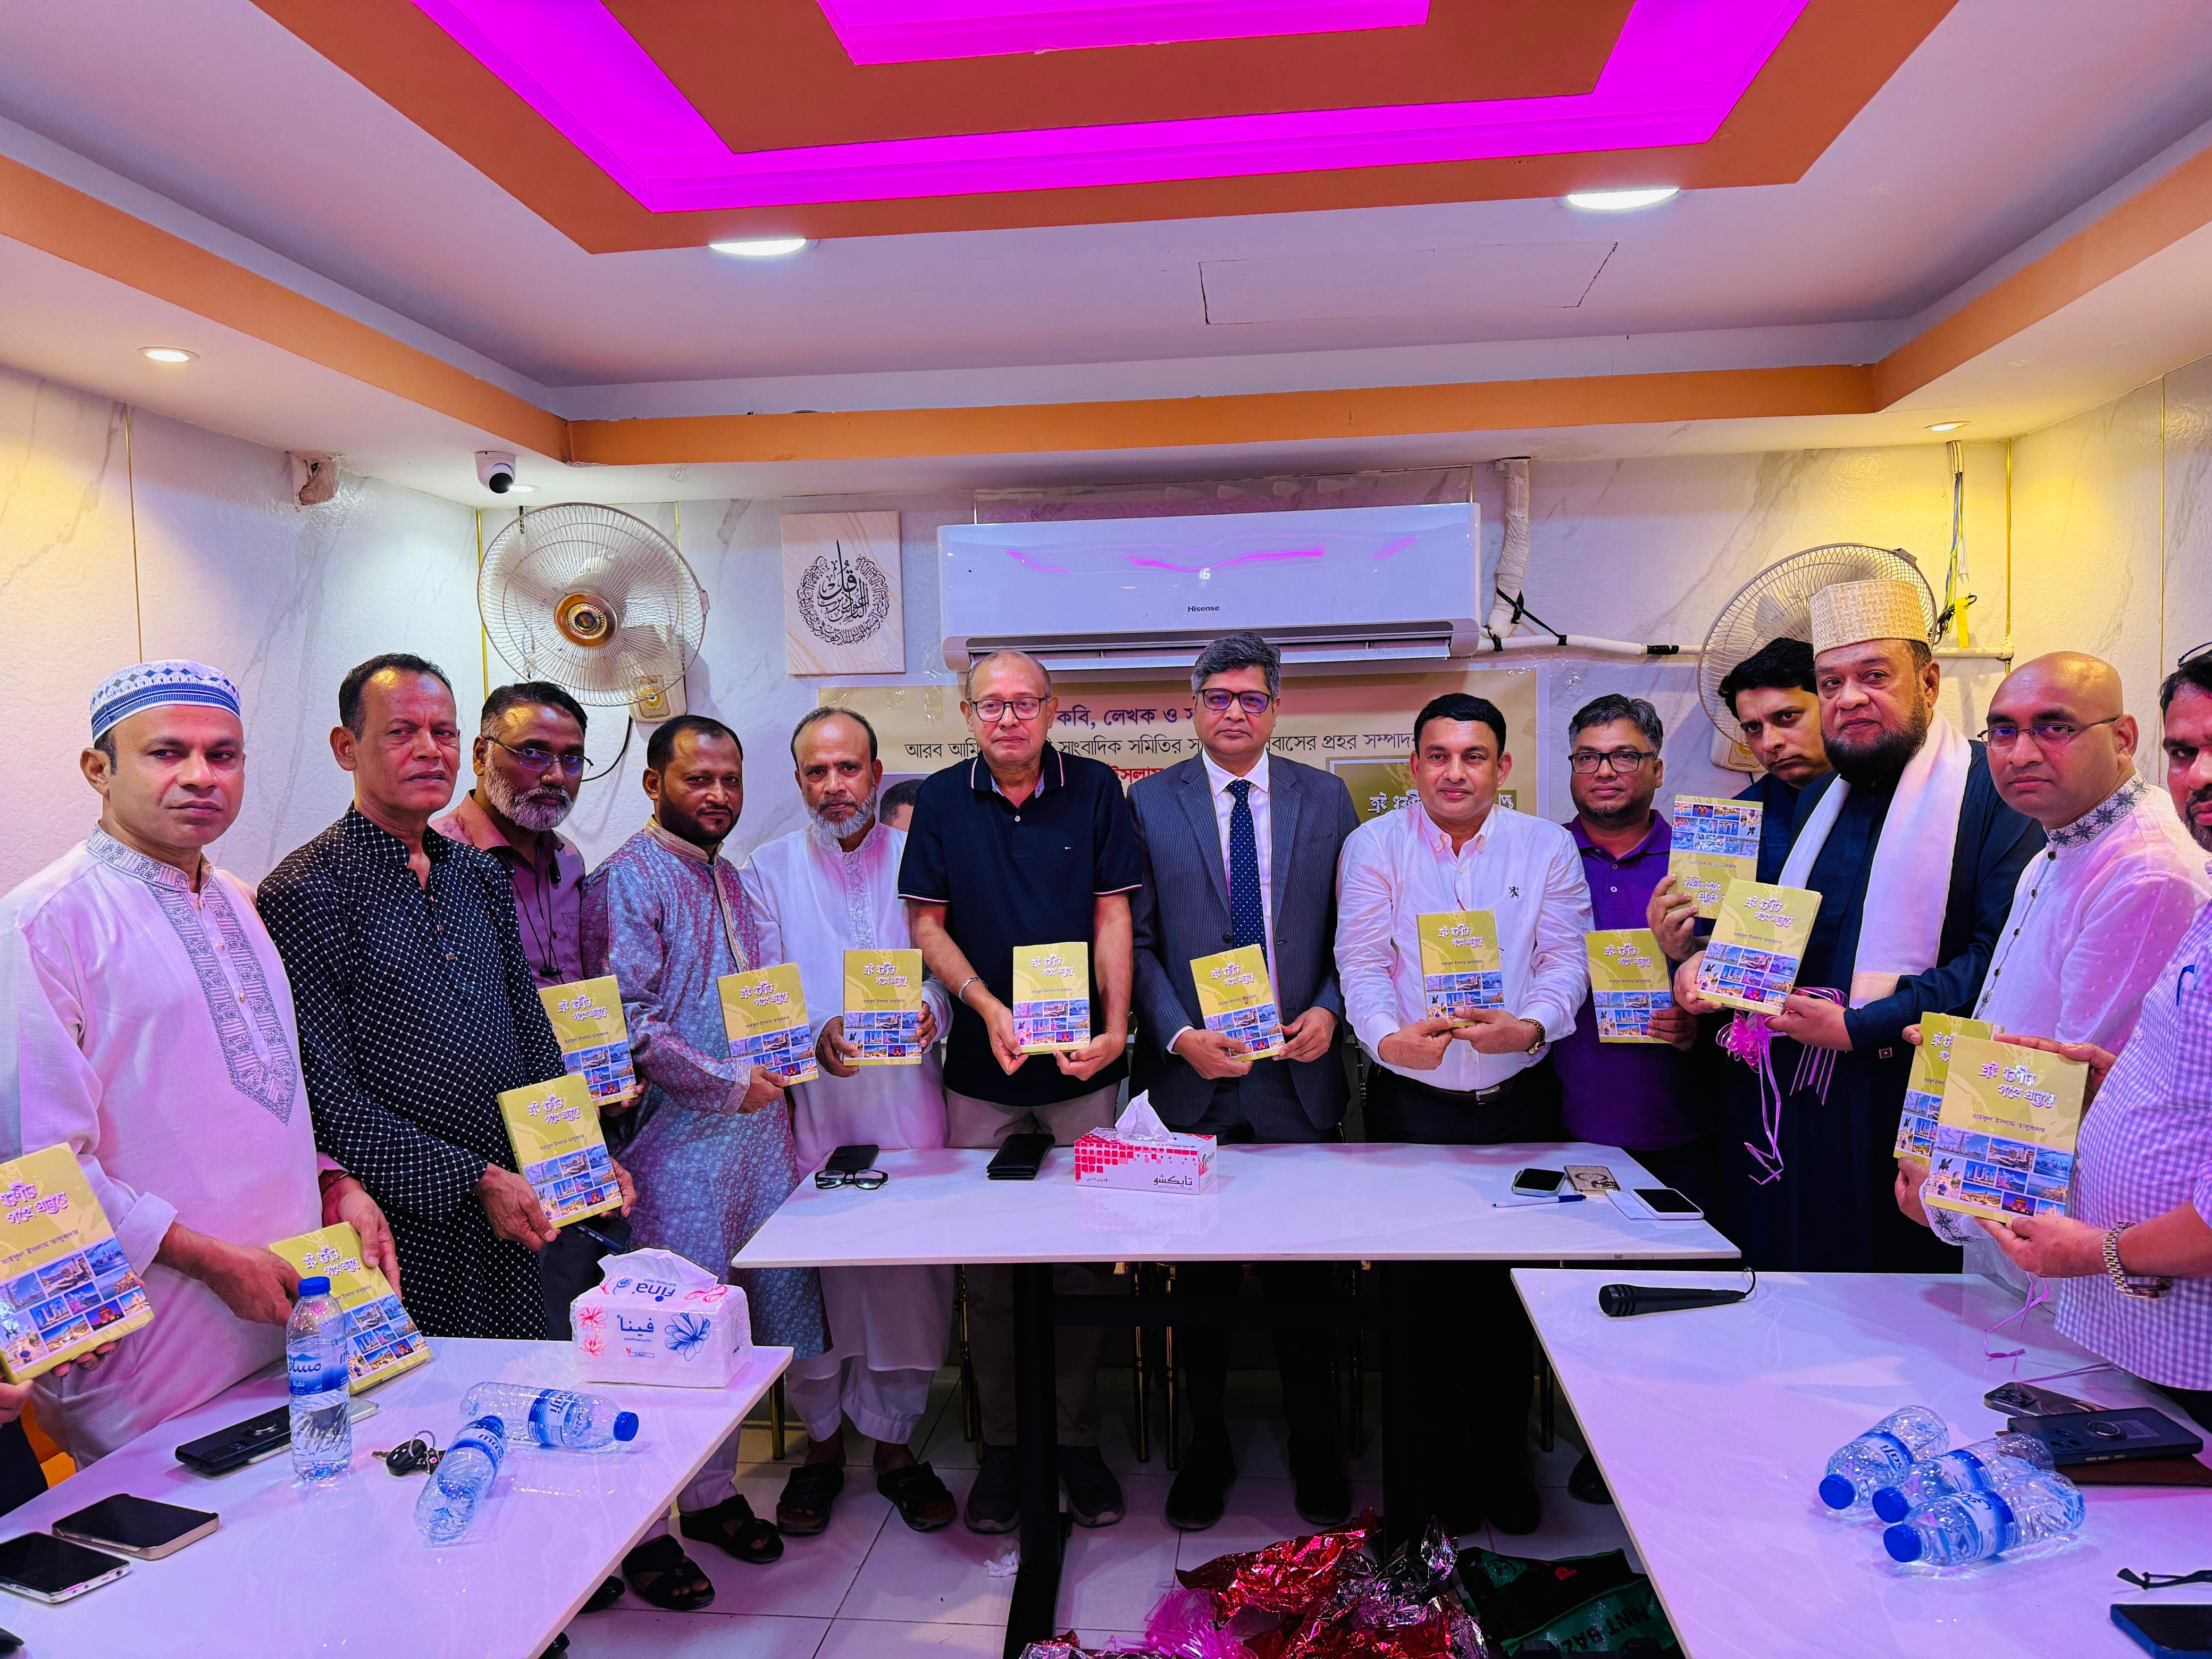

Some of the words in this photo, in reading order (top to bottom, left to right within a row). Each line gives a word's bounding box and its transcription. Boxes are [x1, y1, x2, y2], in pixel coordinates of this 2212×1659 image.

[1200, 568, 1210, 580] 16
[1056, 705, 1096, 730] কবি,
[1104, 708, 1157, 725] লেখক
[1163, 709, 1177, 723] ও
[904, 743, 943, 759] আরব
[948, 738, 979, 758] আমি
[1058, 735, 1122, 756] সাংবাদিক
[1127, 734, 1182, 754] সমিতির
[1322, 735, 1358, 750] প্রহর
[1363, 733, 1414, 748] সম্পাদ
[1978, 1061, 1999, 1079] এই
[2003, 1065, 2036, 1086] ধরণীর
[1998, 1084, 2023, 1101] পথে
[1153, 1174, 1192, 1187] تايكشو
[621, 1317, 653, 1336] فينا
